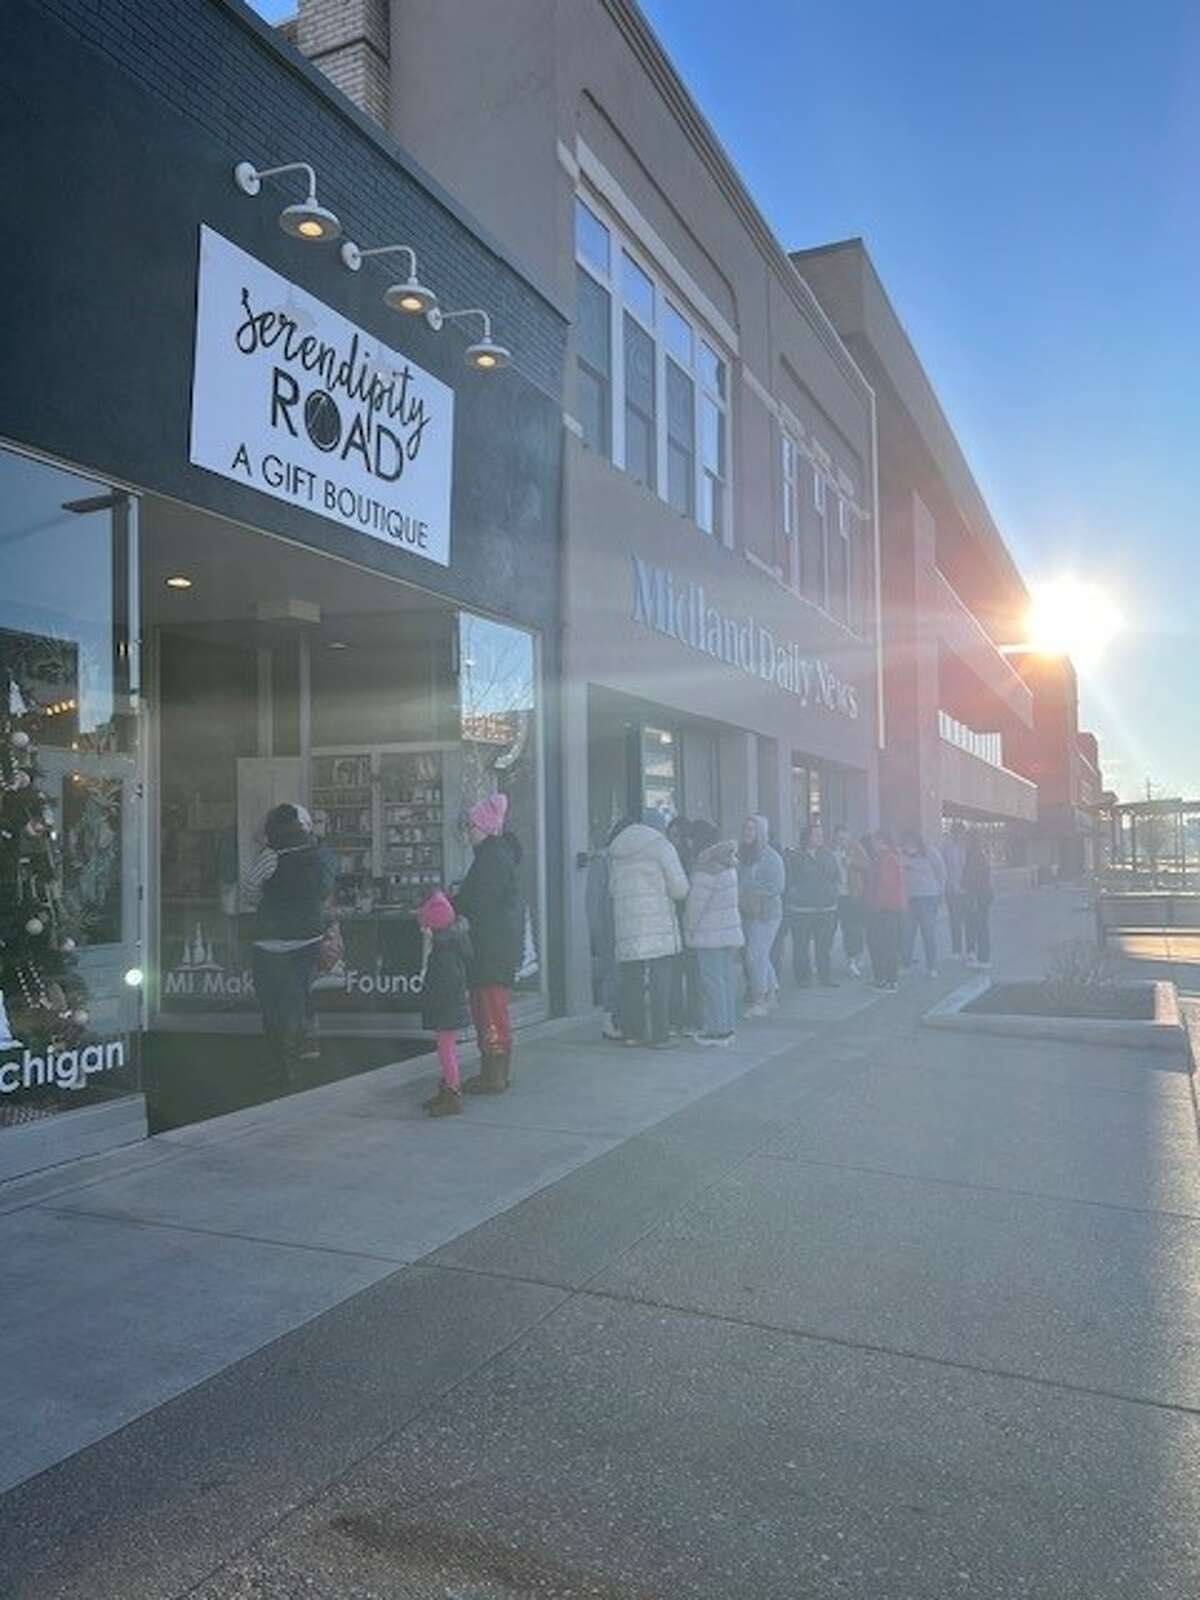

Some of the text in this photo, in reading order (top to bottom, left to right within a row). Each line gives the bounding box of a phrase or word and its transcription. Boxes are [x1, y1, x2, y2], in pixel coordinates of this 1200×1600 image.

[235, 286, 431, 461] Serendipity
[270, 366, 404, 483] ROAD
[231, 443, 429, 549] A GIFT BOUTIQUE
[630, 552, 859, 719] Midland Daily News
[0, 1041, 124, 1093] chigan
